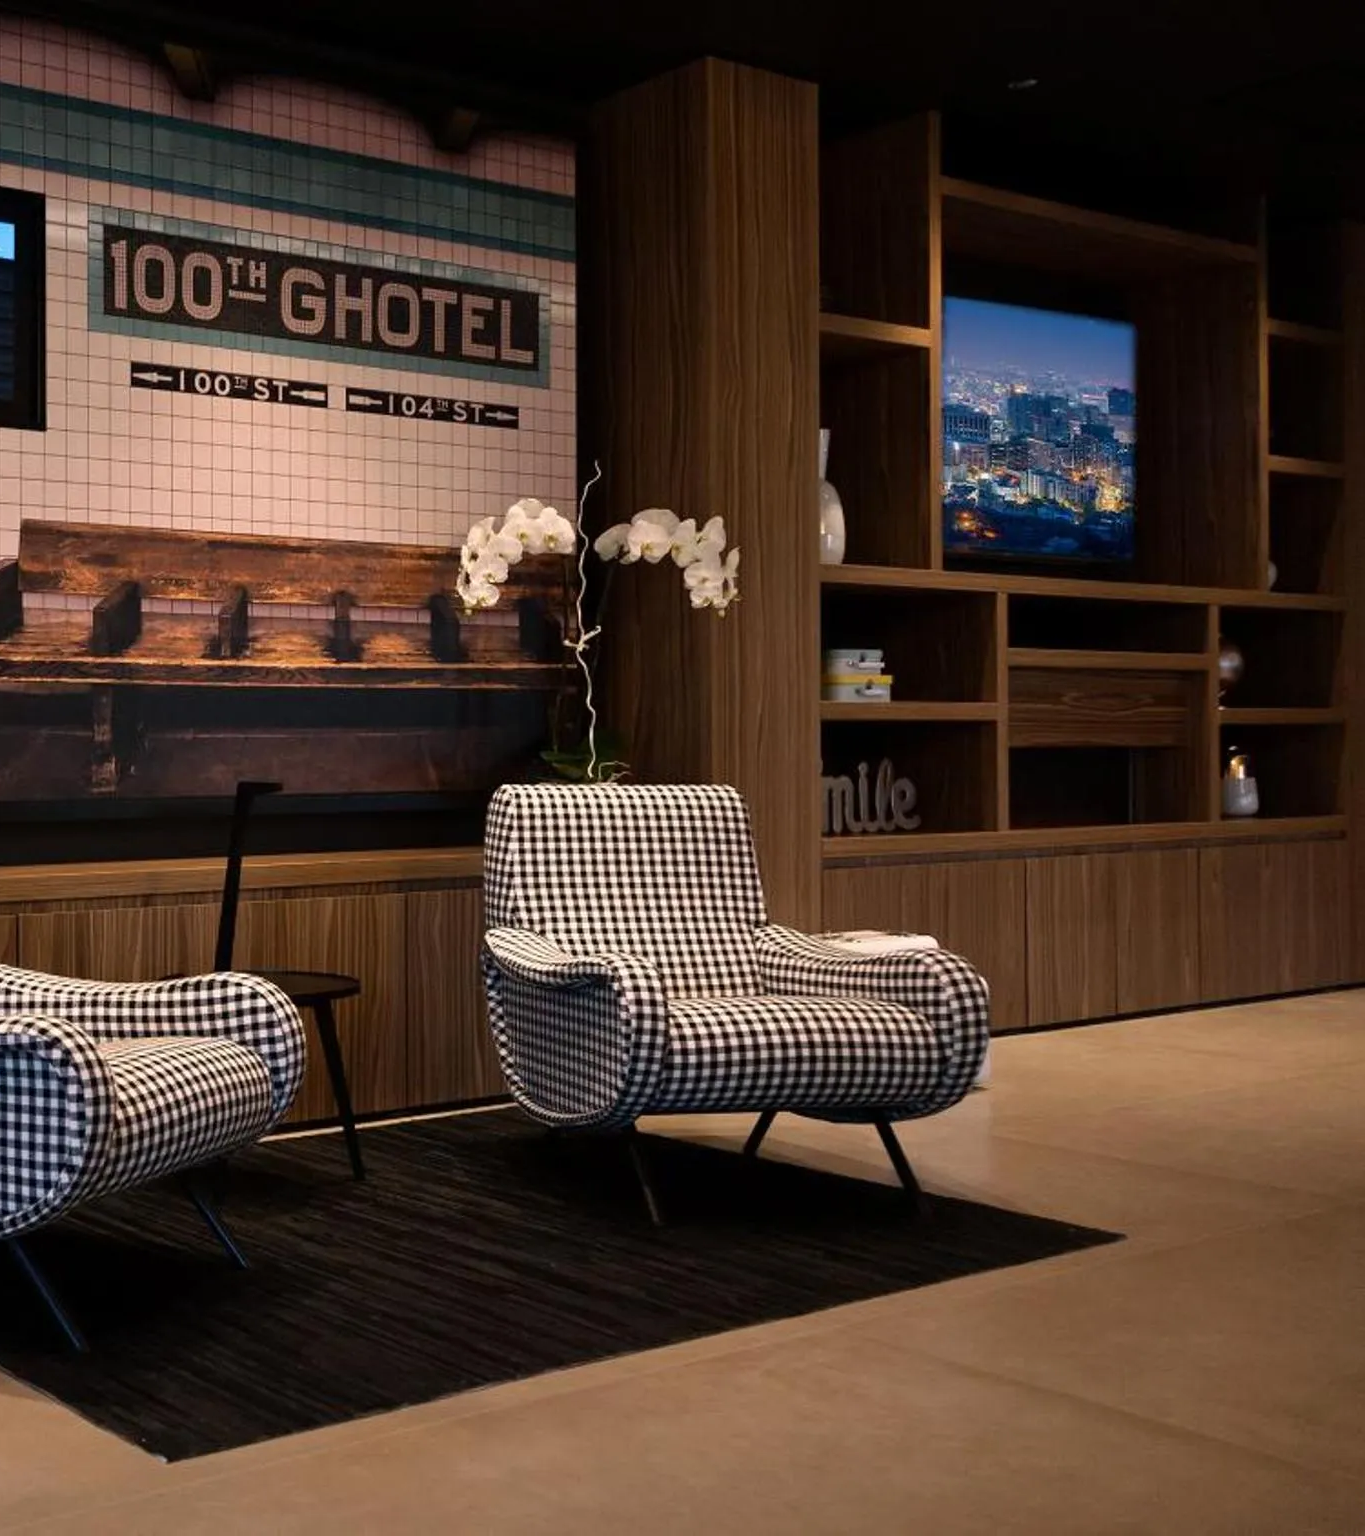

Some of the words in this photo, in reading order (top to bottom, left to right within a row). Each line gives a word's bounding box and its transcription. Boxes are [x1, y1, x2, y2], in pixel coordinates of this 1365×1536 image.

[110, 239, 267, 321] 100TH
[280, 267, 534, 364] GHOTEL
[180, 370, 248, 396] 100TH
[254, 378, 288, 402] ST
[389, 394, 449, 418] 104TH
[453, 401, 485, 423] ST
[820, 757, 921, 833] mile
